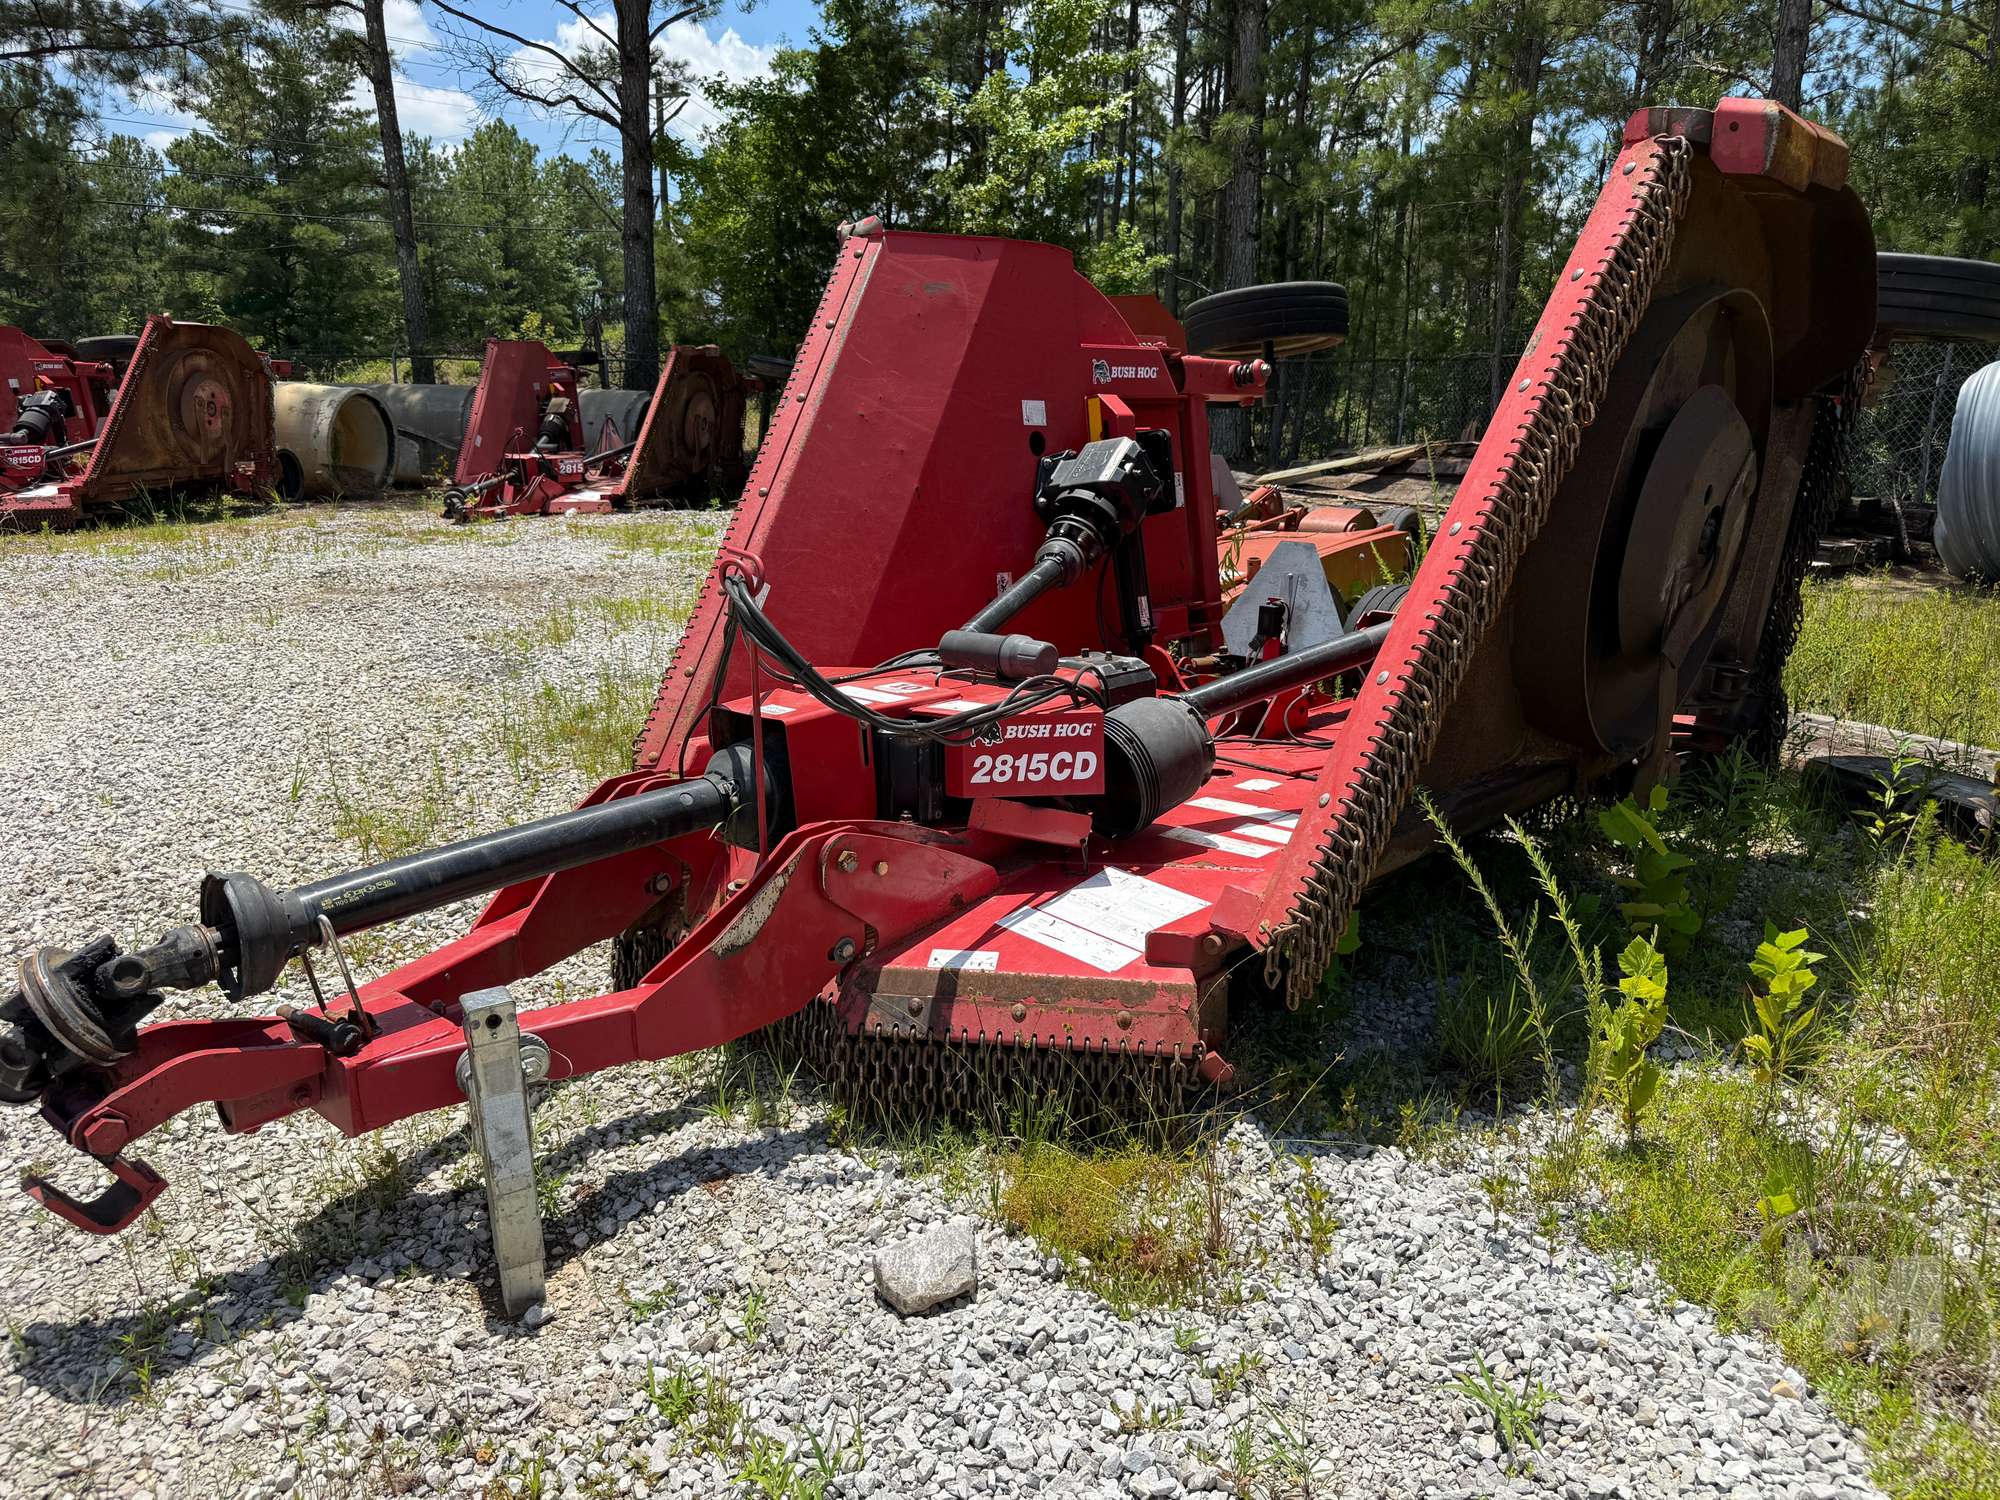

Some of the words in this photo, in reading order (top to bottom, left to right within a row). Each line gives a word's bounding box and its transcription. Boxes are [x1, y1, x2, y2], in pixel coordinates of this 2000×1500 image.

[1111, 366, 1136, 378] BUSH
[1137, 367, 1157, 379] HOG
[560, 463, 584, 474] 2815
[1005, 724, 1052, 739] BUSH
[1053, 723, 1093, 738] HOG
[970, 751, 1098, 784] 2815CD
